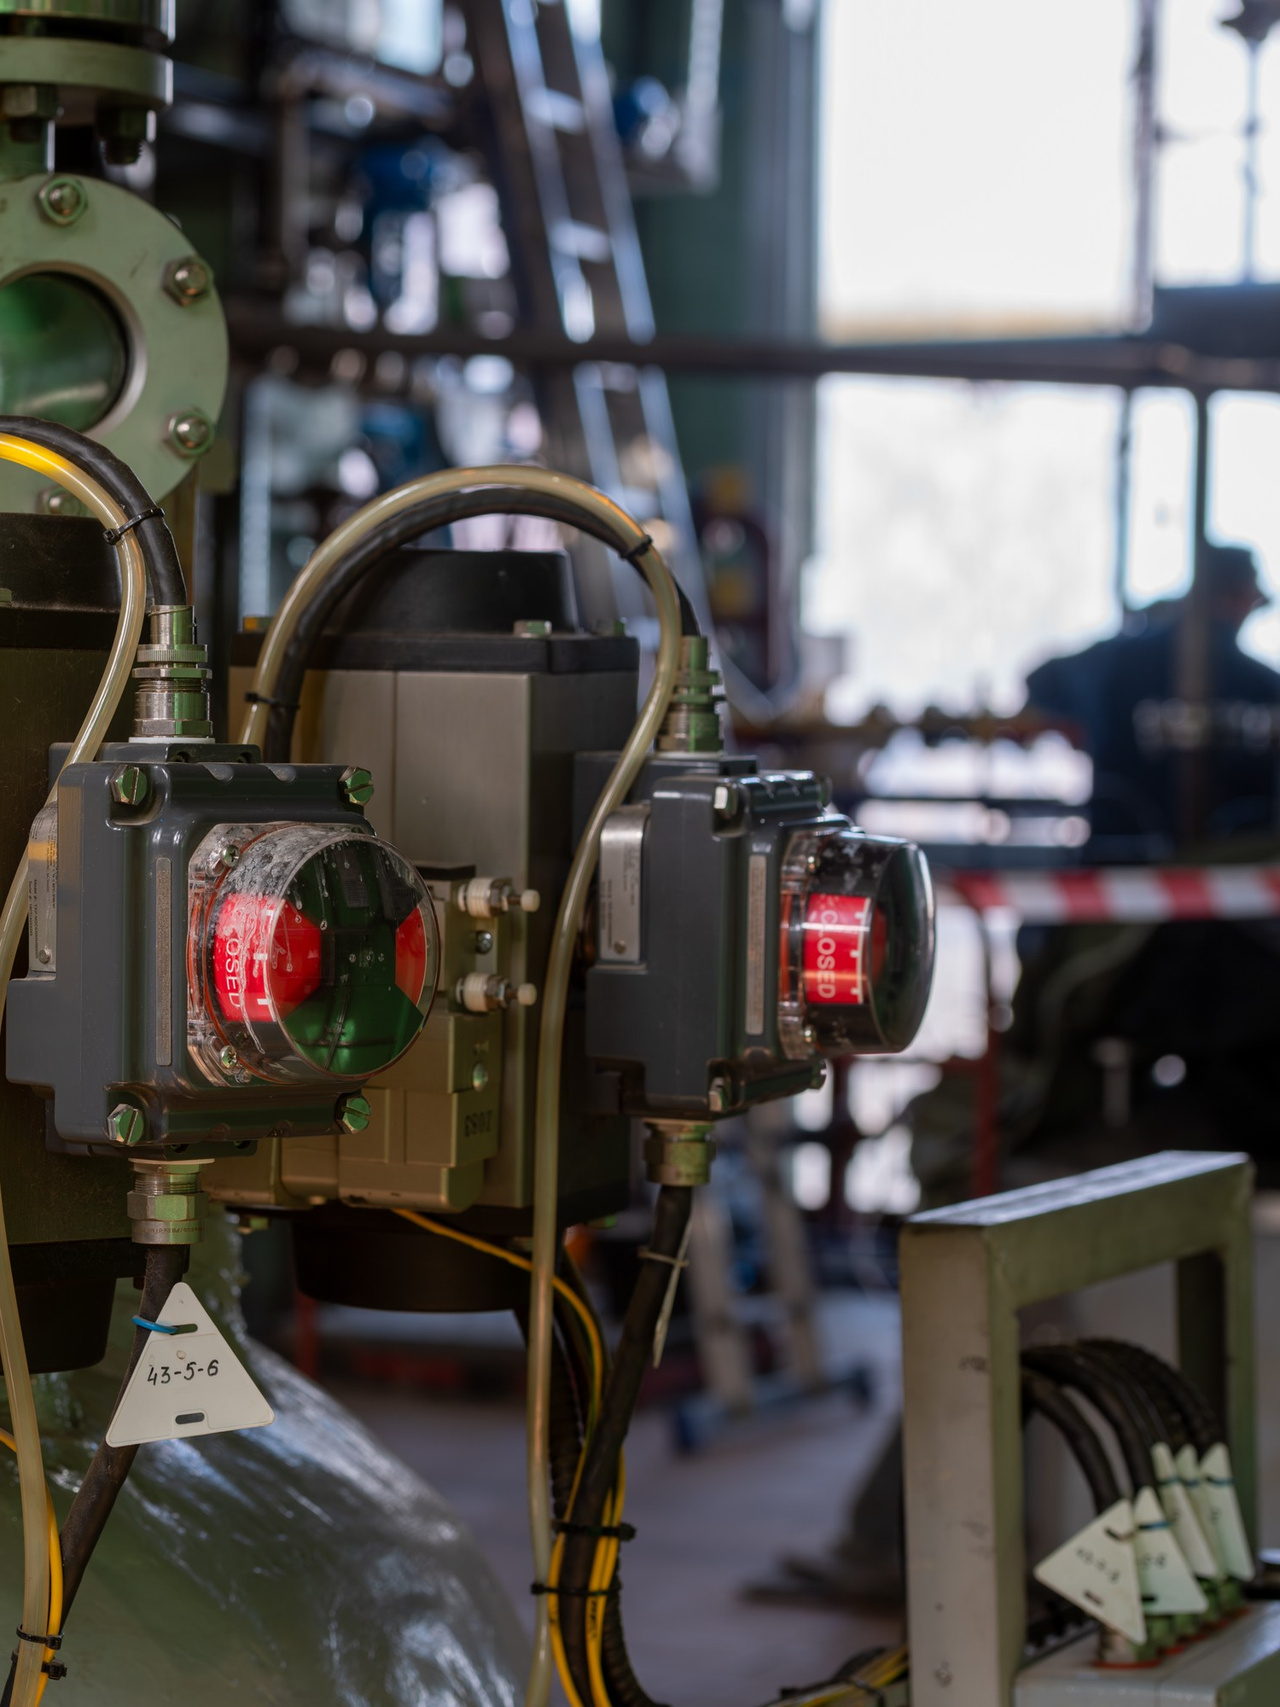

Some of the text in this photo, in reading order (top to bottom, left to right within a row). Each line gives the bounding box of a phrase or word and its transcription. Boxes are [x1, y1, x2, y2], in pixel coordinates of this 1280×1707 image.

[225, 938, 241, 1008] OSED
[817, 910, 838, 999] CLOSED
[147, 1358, 220, 1387] 43-5-6
